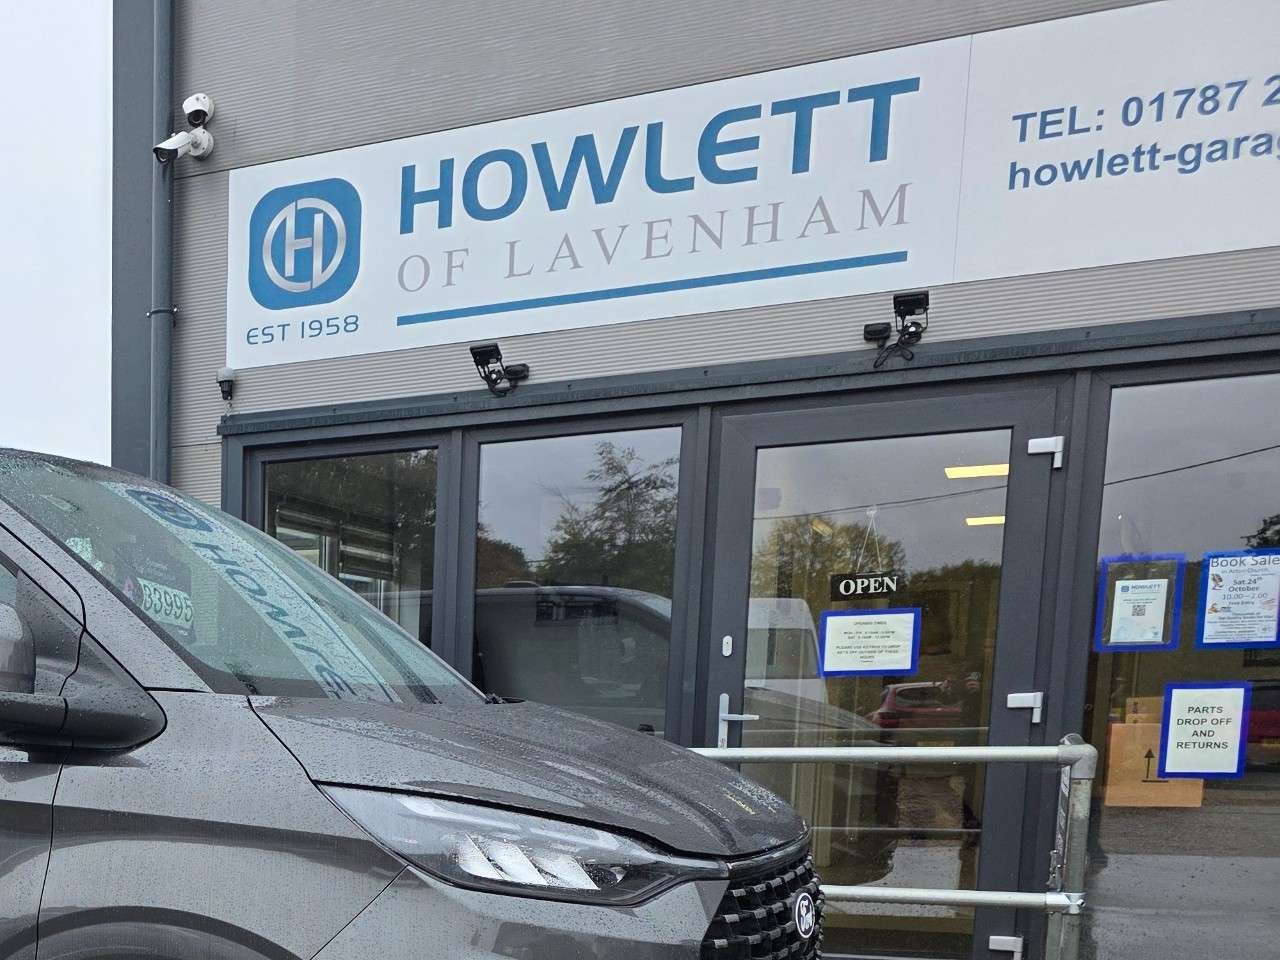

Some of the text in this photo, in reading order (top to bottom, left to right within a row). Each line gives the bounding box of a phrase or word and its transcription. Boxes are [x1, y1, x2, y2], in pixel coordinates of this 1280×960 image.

[1011, 108, 1105, 143] TEL:
[1121, 79, 1249, 127] 01787
[399, 76, 921, 235] HOWLETT
[1007, 132, 1280, 191] howlett-gara
[397, 182, 915, 293] OF LAVENHAM
[245, 314, 361, 346] EST 1958
[1210, 555, 1280, 568] Book Sale
[839, 576, 898, 596] OPEN
[1187, 706, 1224, 714] PARTS
[1176, 717, 1232, 726] DROP OFF
[1191, 729, 1215, 738] AND
[1176, 741, 1229, 750] RETURNS
